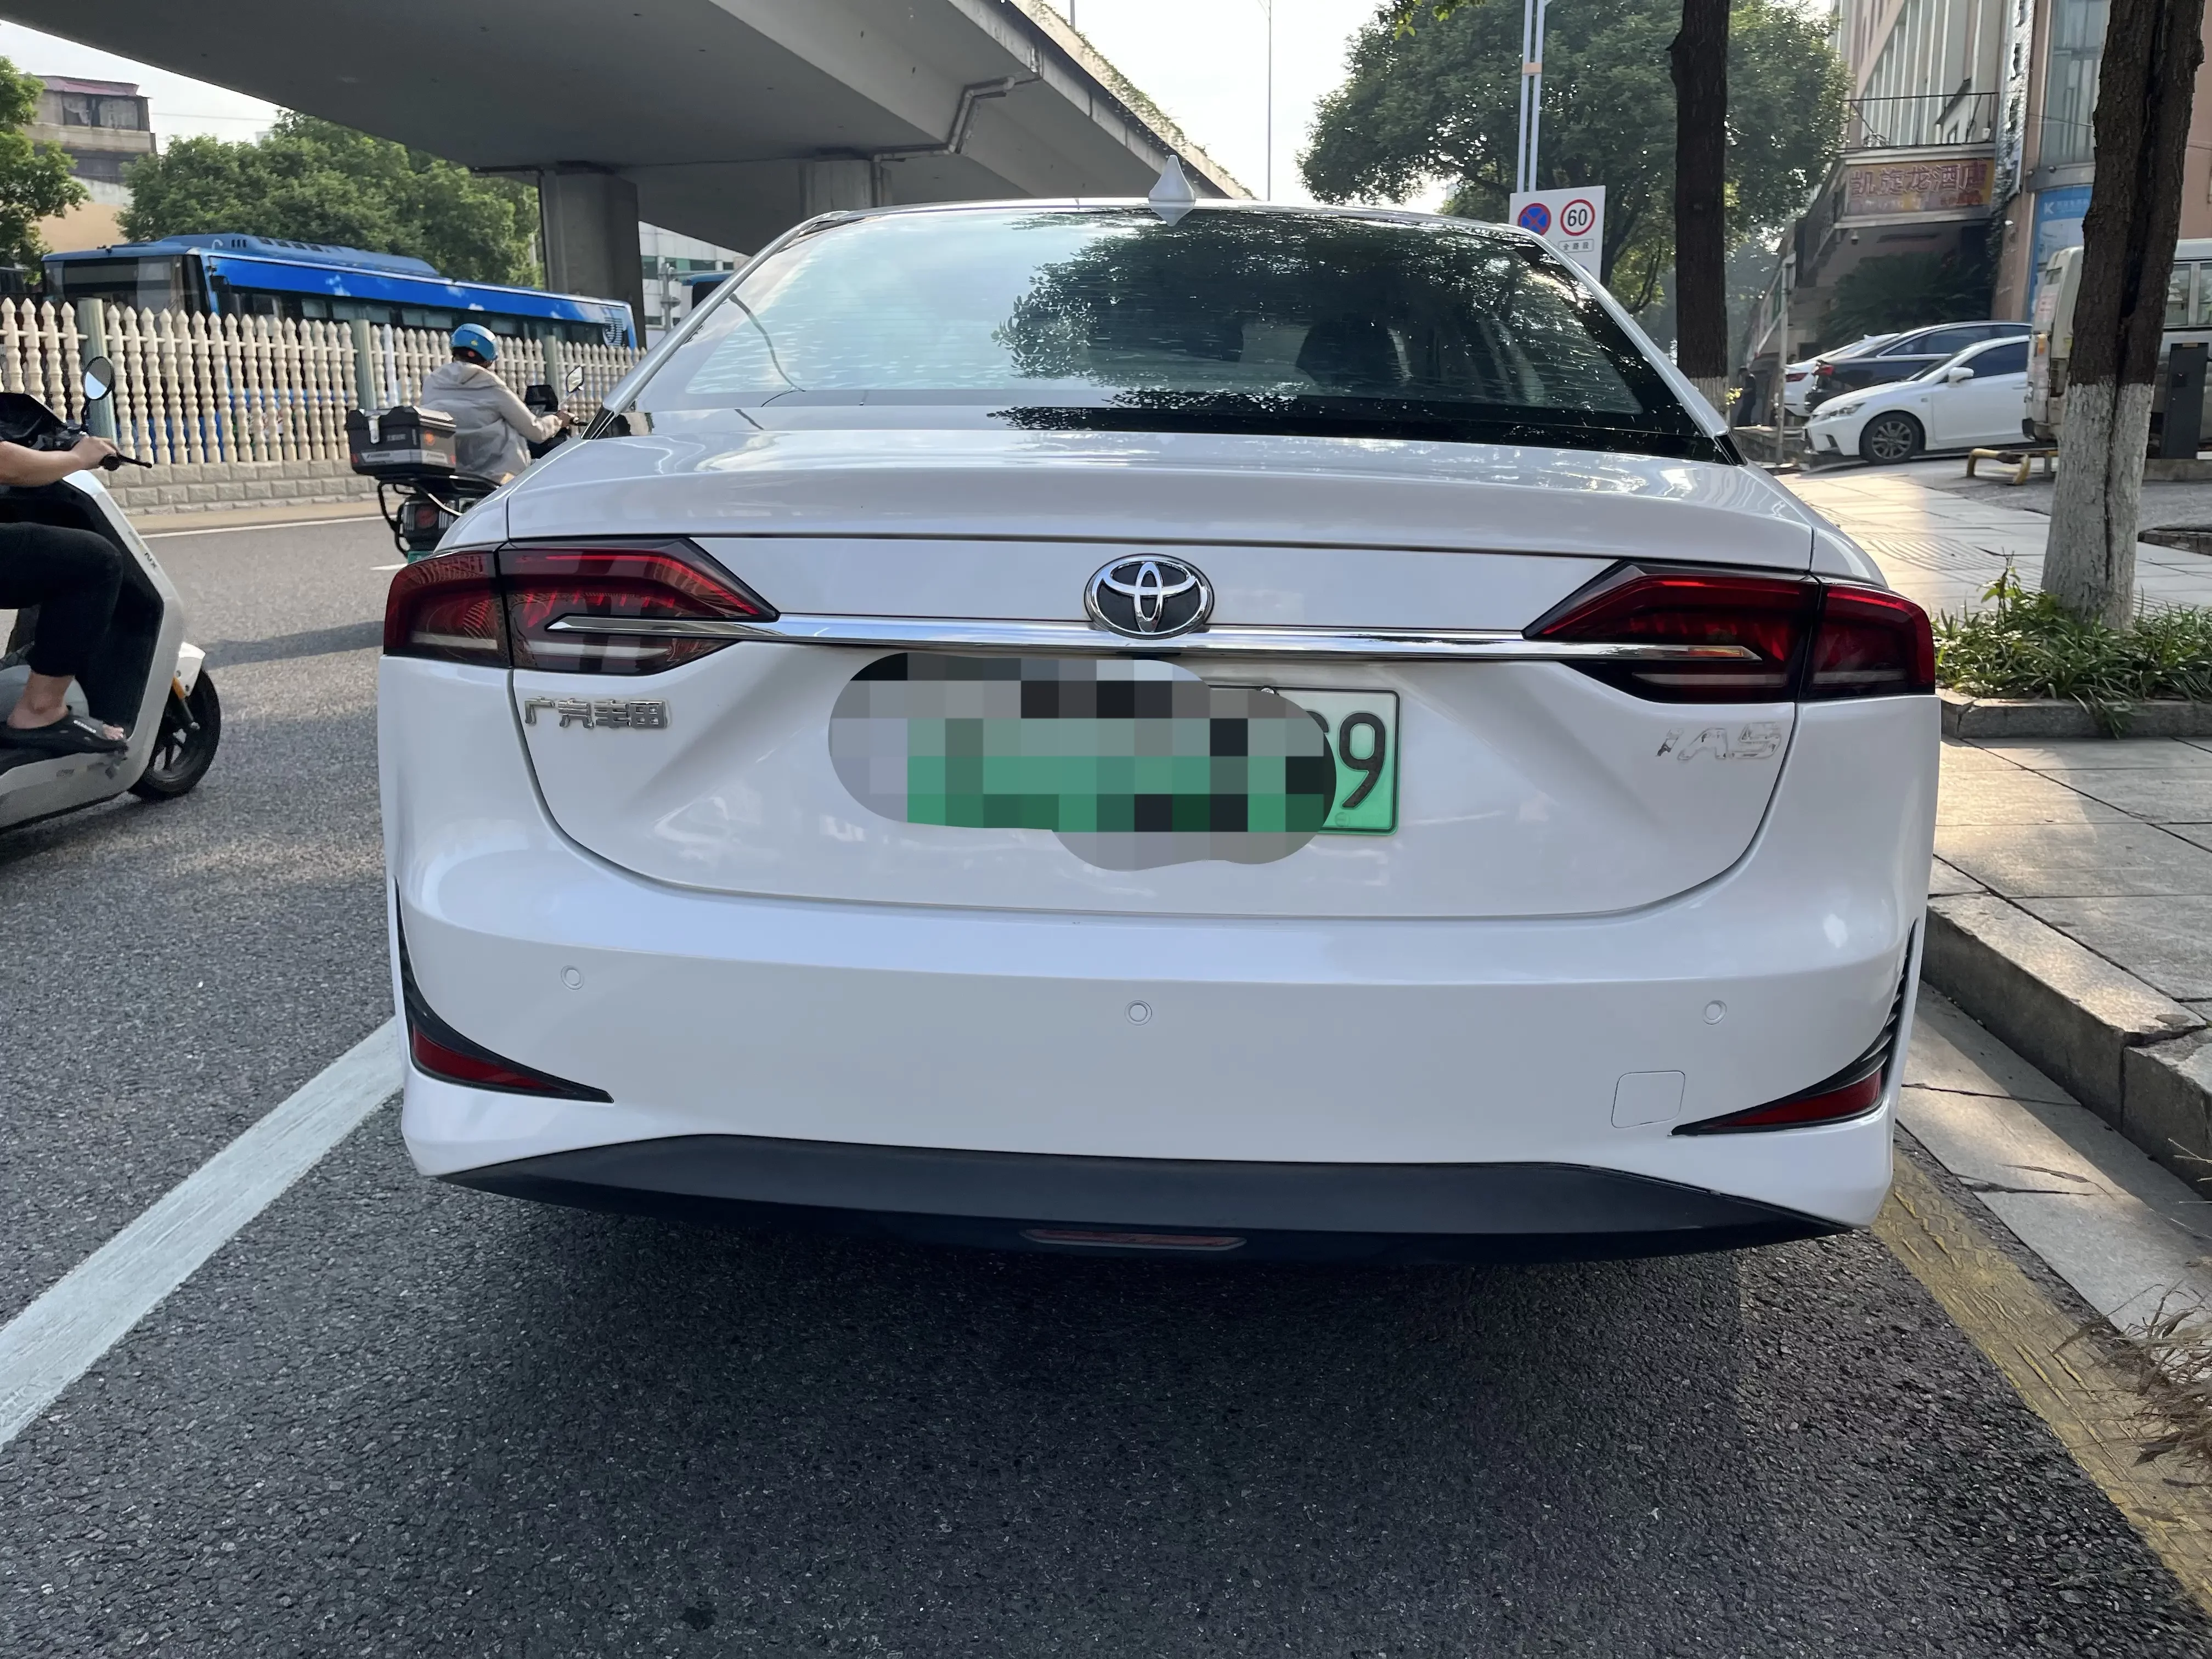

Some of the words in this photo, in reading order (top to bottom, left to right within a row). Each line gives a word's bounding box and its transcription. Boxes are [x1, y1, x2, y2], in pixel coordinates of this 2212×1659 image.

[1568, 208, 1587, 226] 60
[1563, 242, 1589, 251] 全路段
